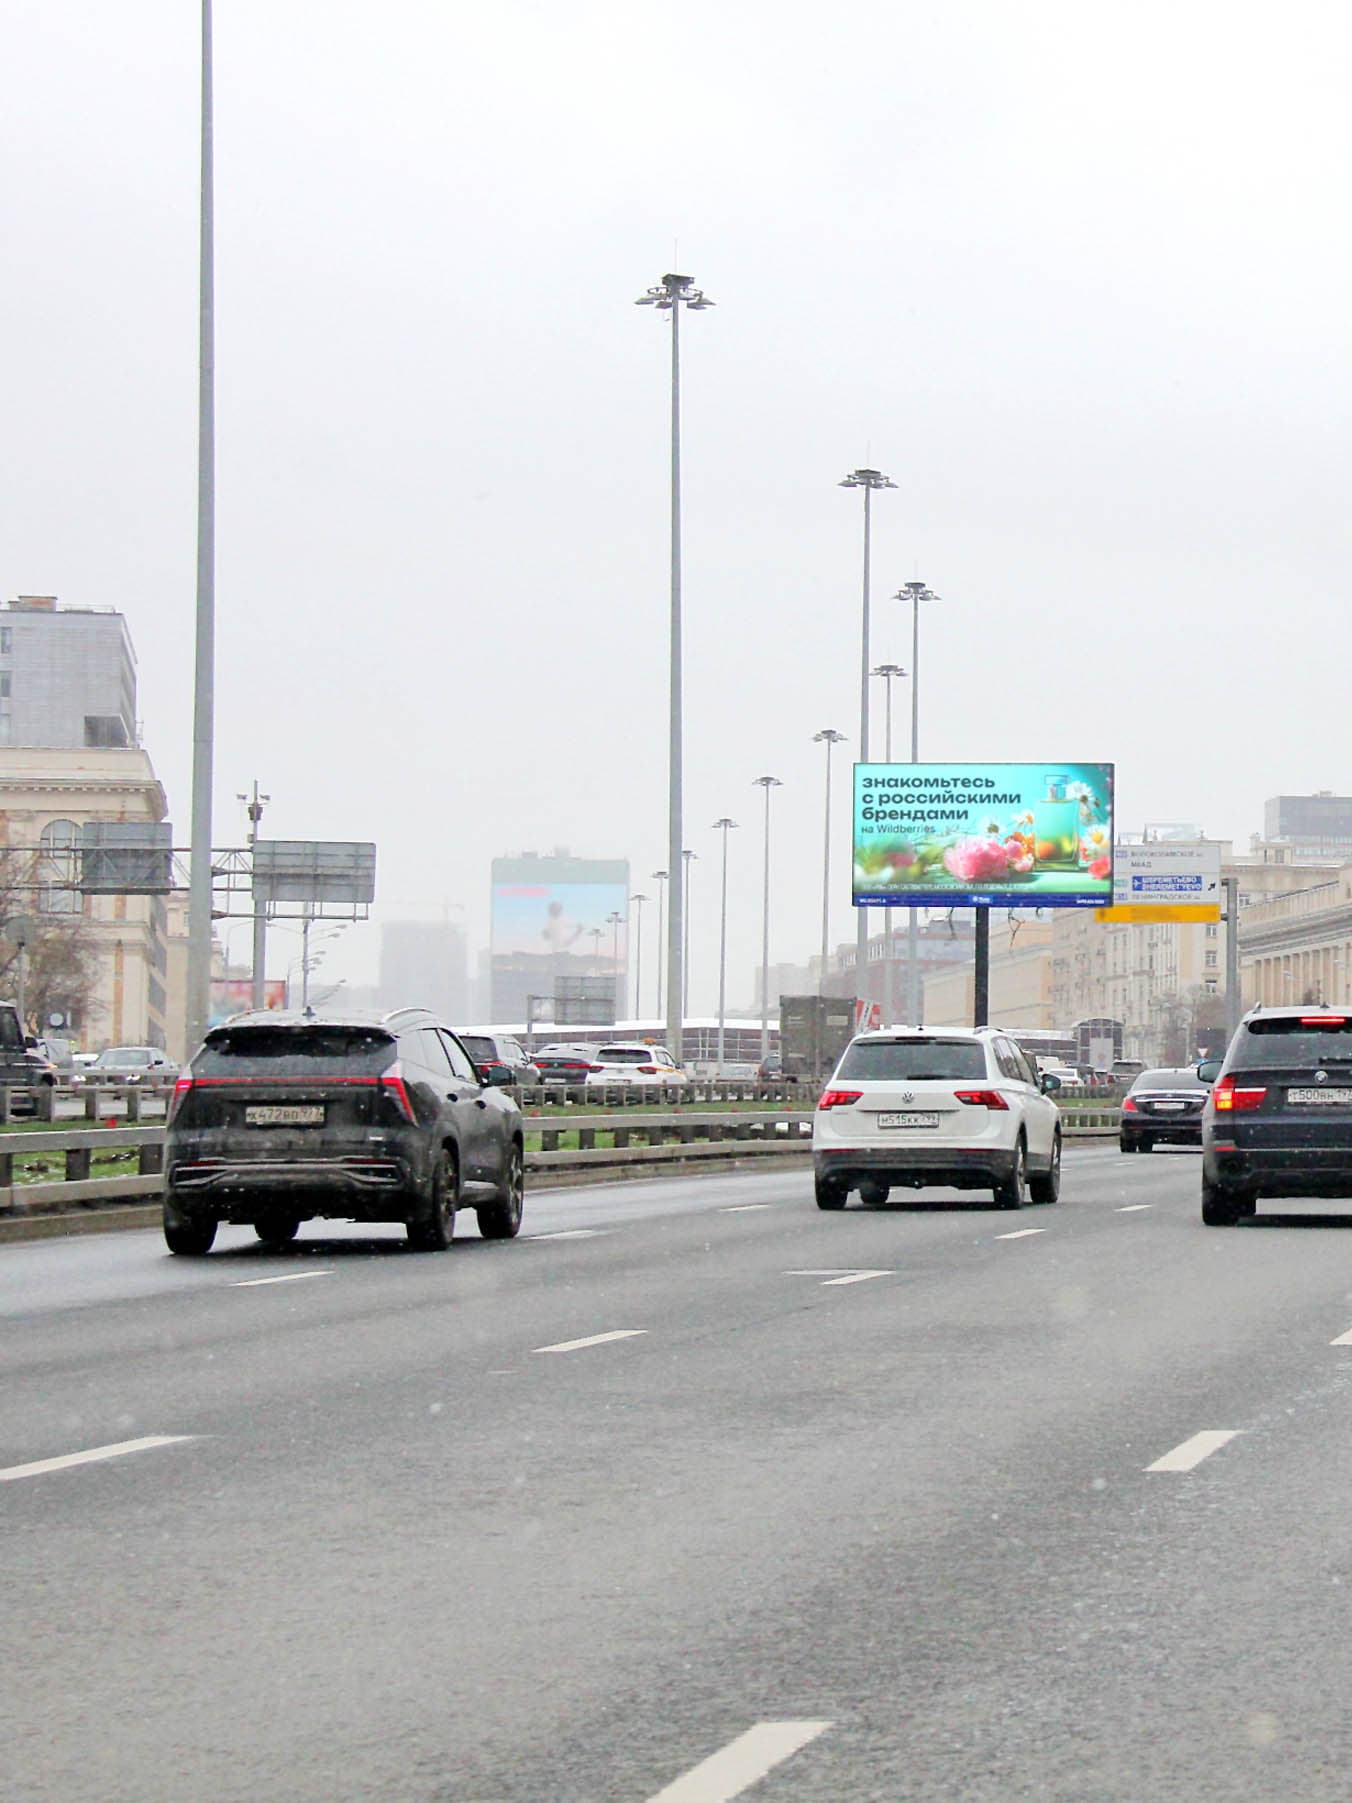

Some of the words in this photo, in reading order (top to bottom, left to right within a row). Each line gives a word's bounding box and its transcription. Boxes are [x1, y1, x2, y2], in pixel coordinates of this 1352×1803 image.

[862, 777, 995, 789] знакомьтесь
[862, 793, 874, 804] с
[878, 790, 1021, 806] российскими
[862, 806, 969, 822] брендами
[876, 824, 936, 834] Wildberries
